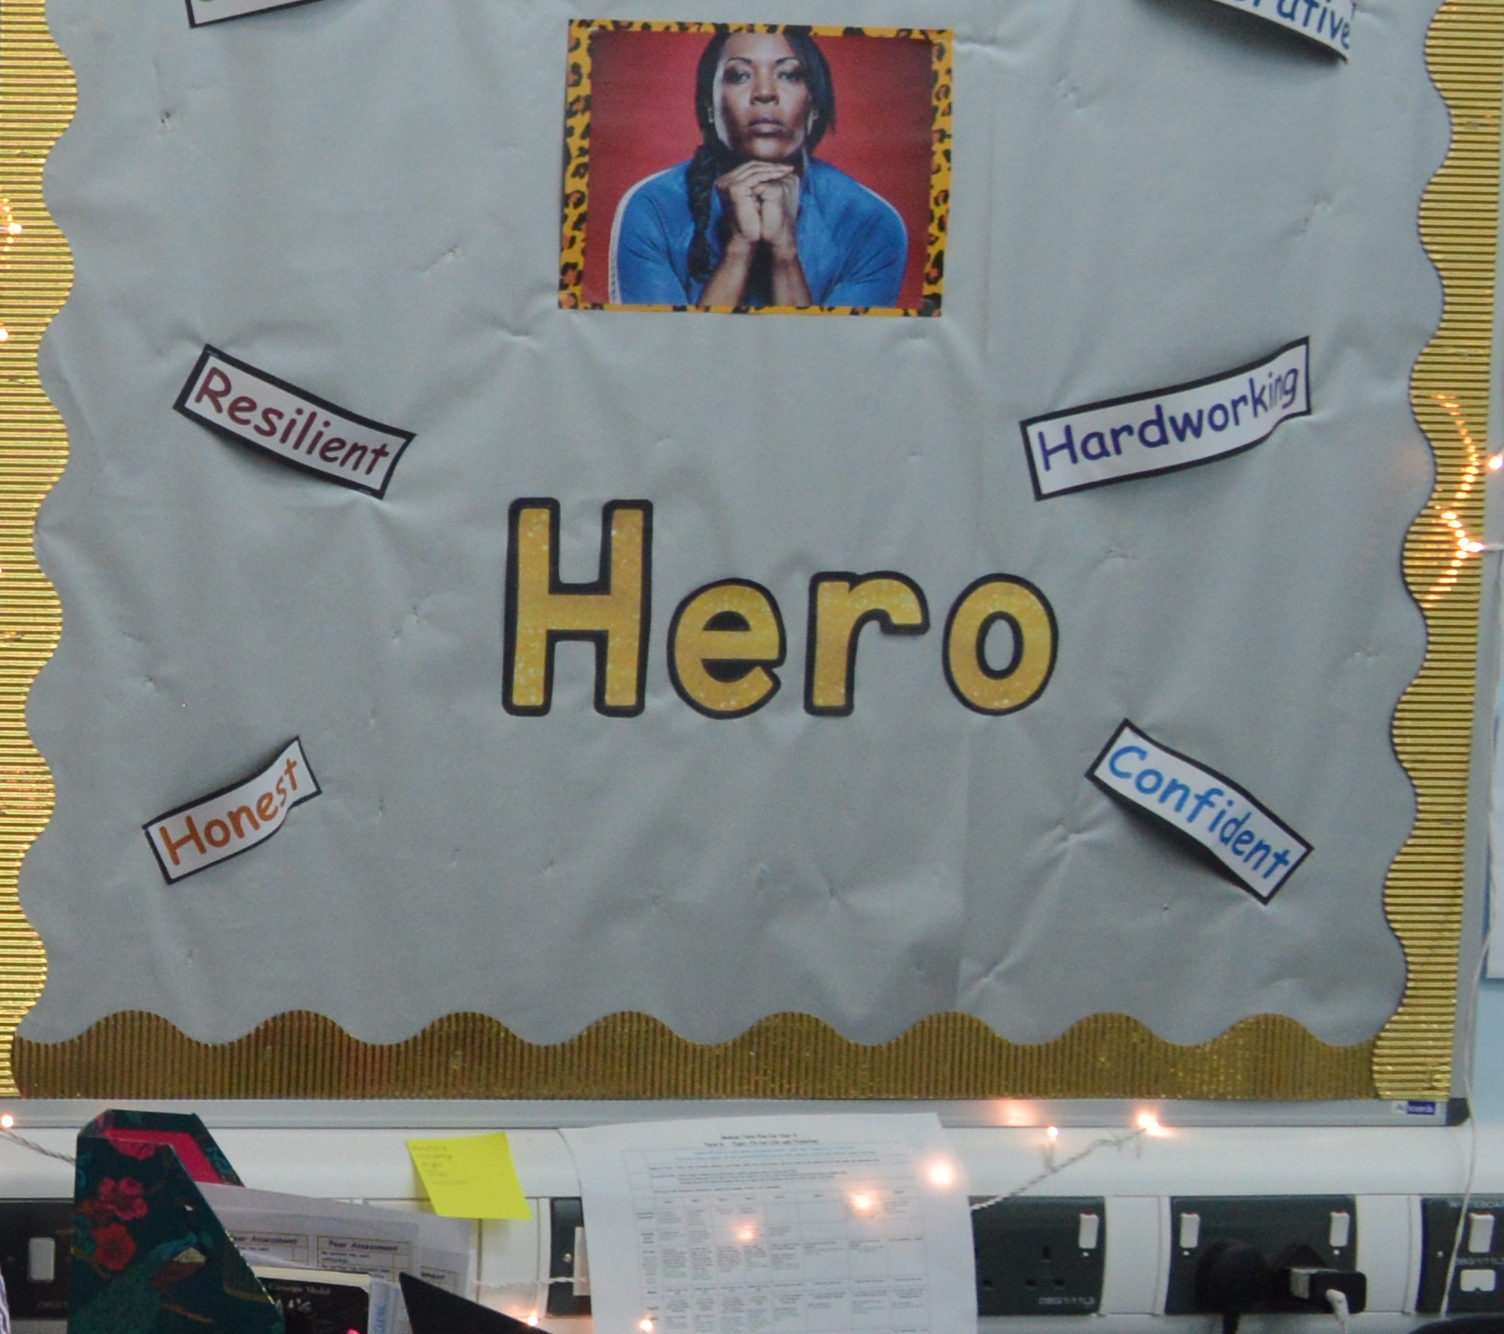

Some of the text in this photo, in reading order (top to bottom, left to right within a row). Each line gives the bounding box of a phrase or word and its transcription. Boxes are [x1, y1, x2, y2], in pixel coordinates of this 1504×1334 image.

[194, 364, 388, 479] Resilient
[1038, 368, 1300, 474] Hardworking
[501, 496, 1060, 719] Hero
[157, 756, 303, 869] Honest
[1106, 741, 1291, 881] Confident
